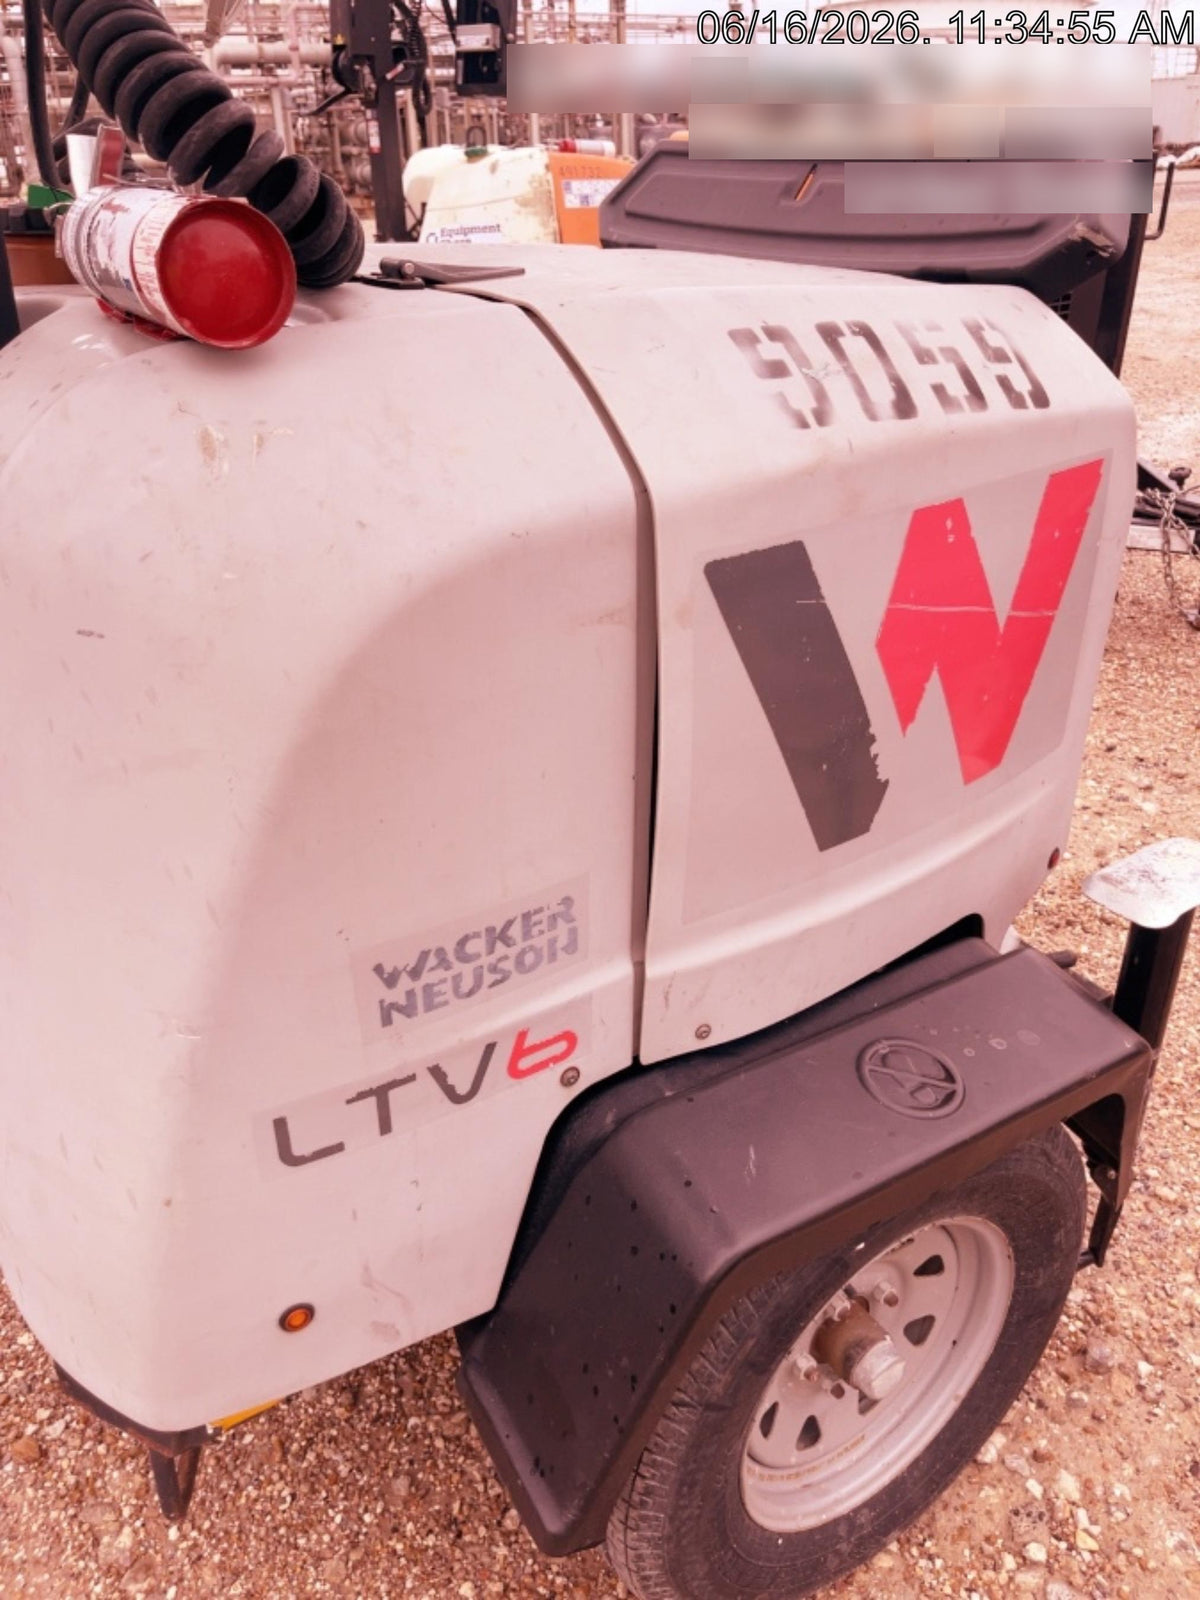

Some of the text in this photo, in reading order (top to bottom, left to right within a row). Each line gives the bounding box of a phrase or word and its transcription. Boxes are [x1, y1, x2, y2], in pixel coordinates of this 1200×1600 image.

[440, 223, 502, 238] Equipment
[726, 317, 1051, 430] 9059
[372, 895, 577, 990] WACKER
[378, 925, 579, 1028] NEUSON
[272, 1027, 579, 1167] LTV6
